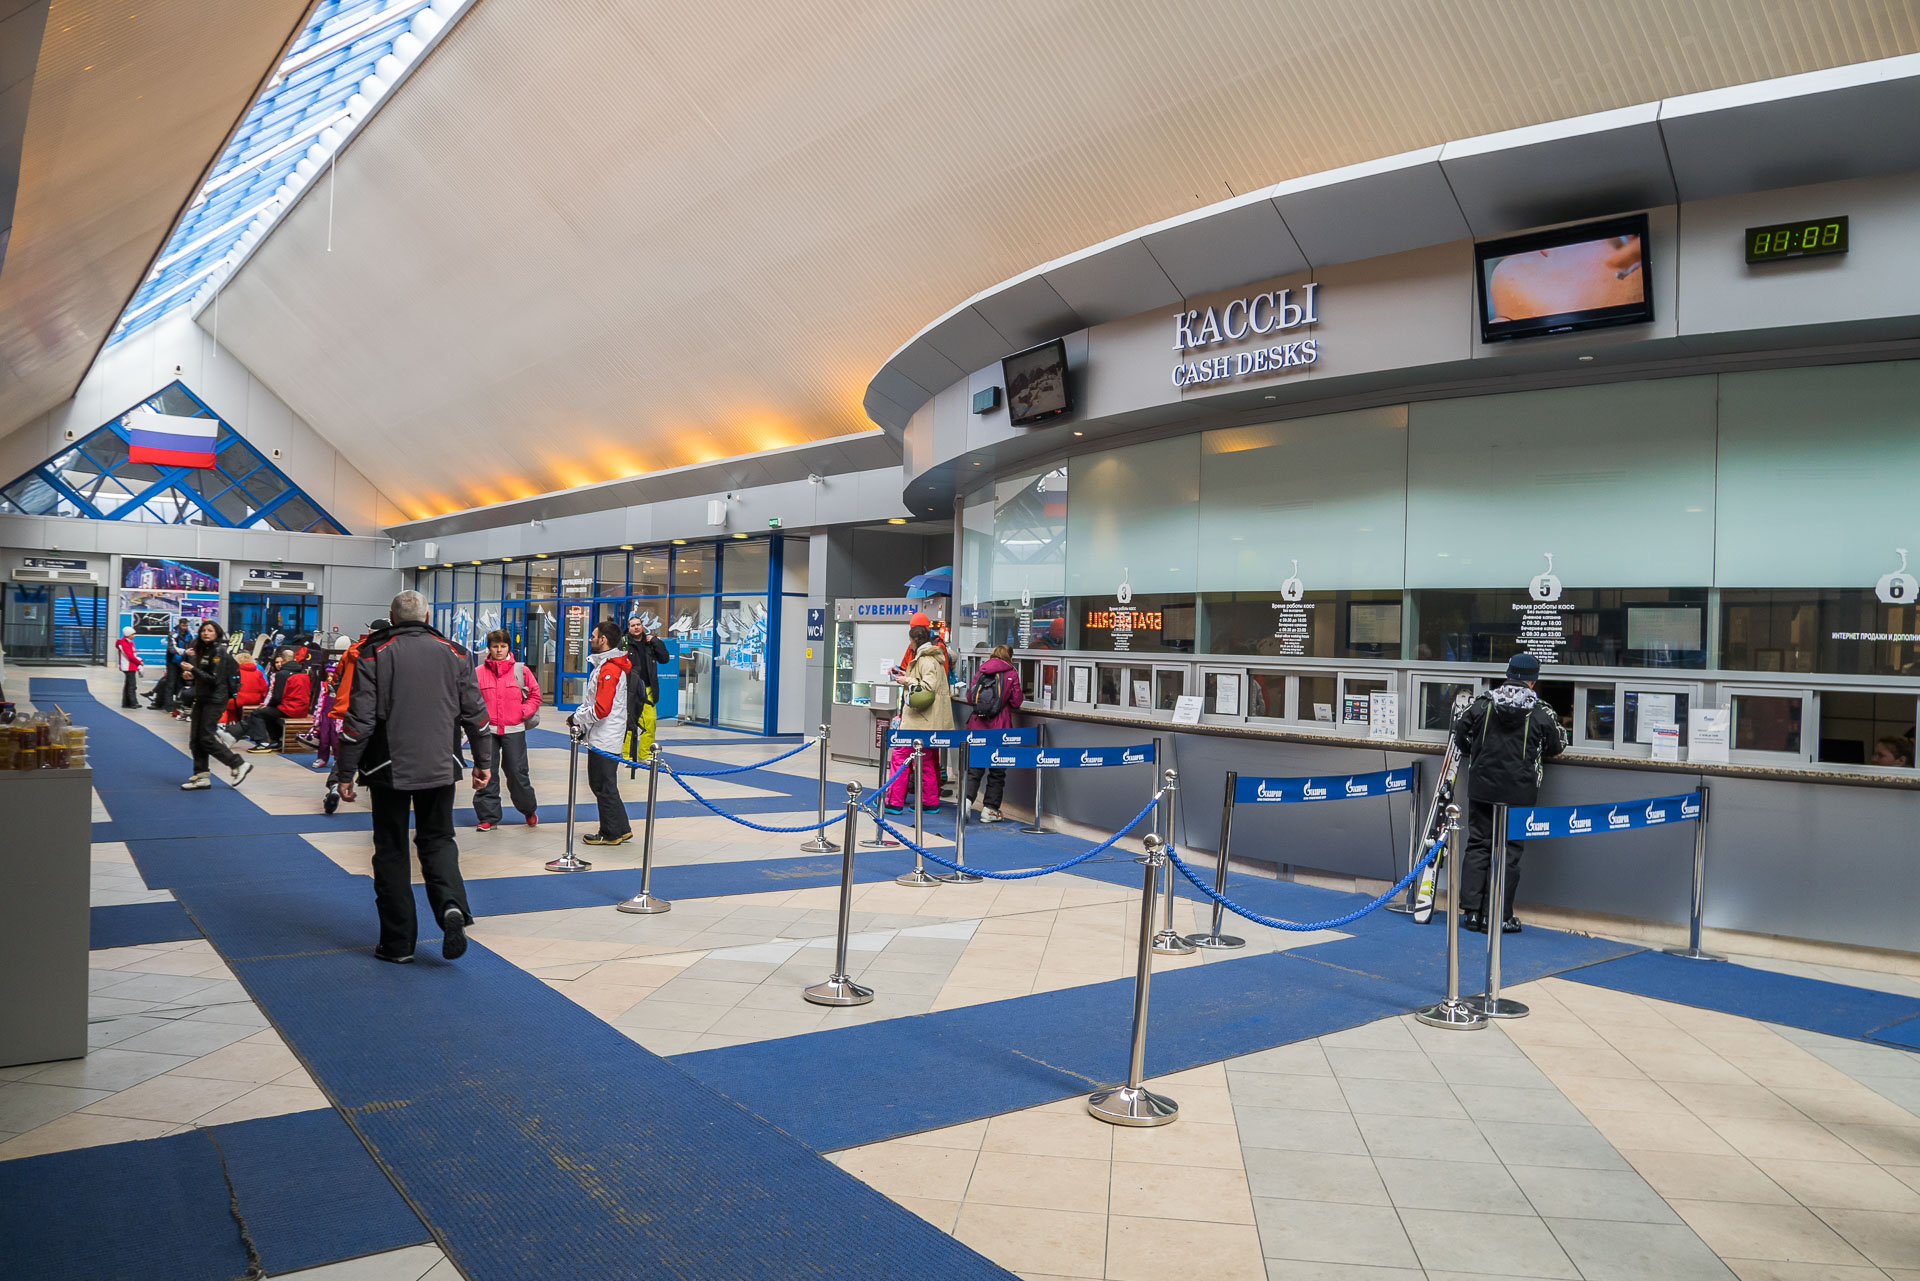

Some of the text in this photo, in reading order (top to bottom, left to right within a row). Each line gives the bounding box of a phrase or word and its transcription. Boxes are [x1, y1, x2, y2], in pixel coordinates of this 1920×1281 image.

[1757, 224, 1839, 253] 11:07
[1172, 283, 1319, 350] КАССЫ
[1171, 339, 1319, 387] CASH DESKS
[1122, 587, 1127, 600] 3
[1288, 582, 1297, 597] 4
[1539, 579, 1551, 596] 5
[1890, 578, 1904, 598] 6
[858, 604, 918, 615] СУВЕНИРЫ
[808, 626, 819, 637] WC
[1832, 632, 1860, 640] ИНТЕРНЕТ
[1860, 633, 1888, 641] ПРОДАЖИ
